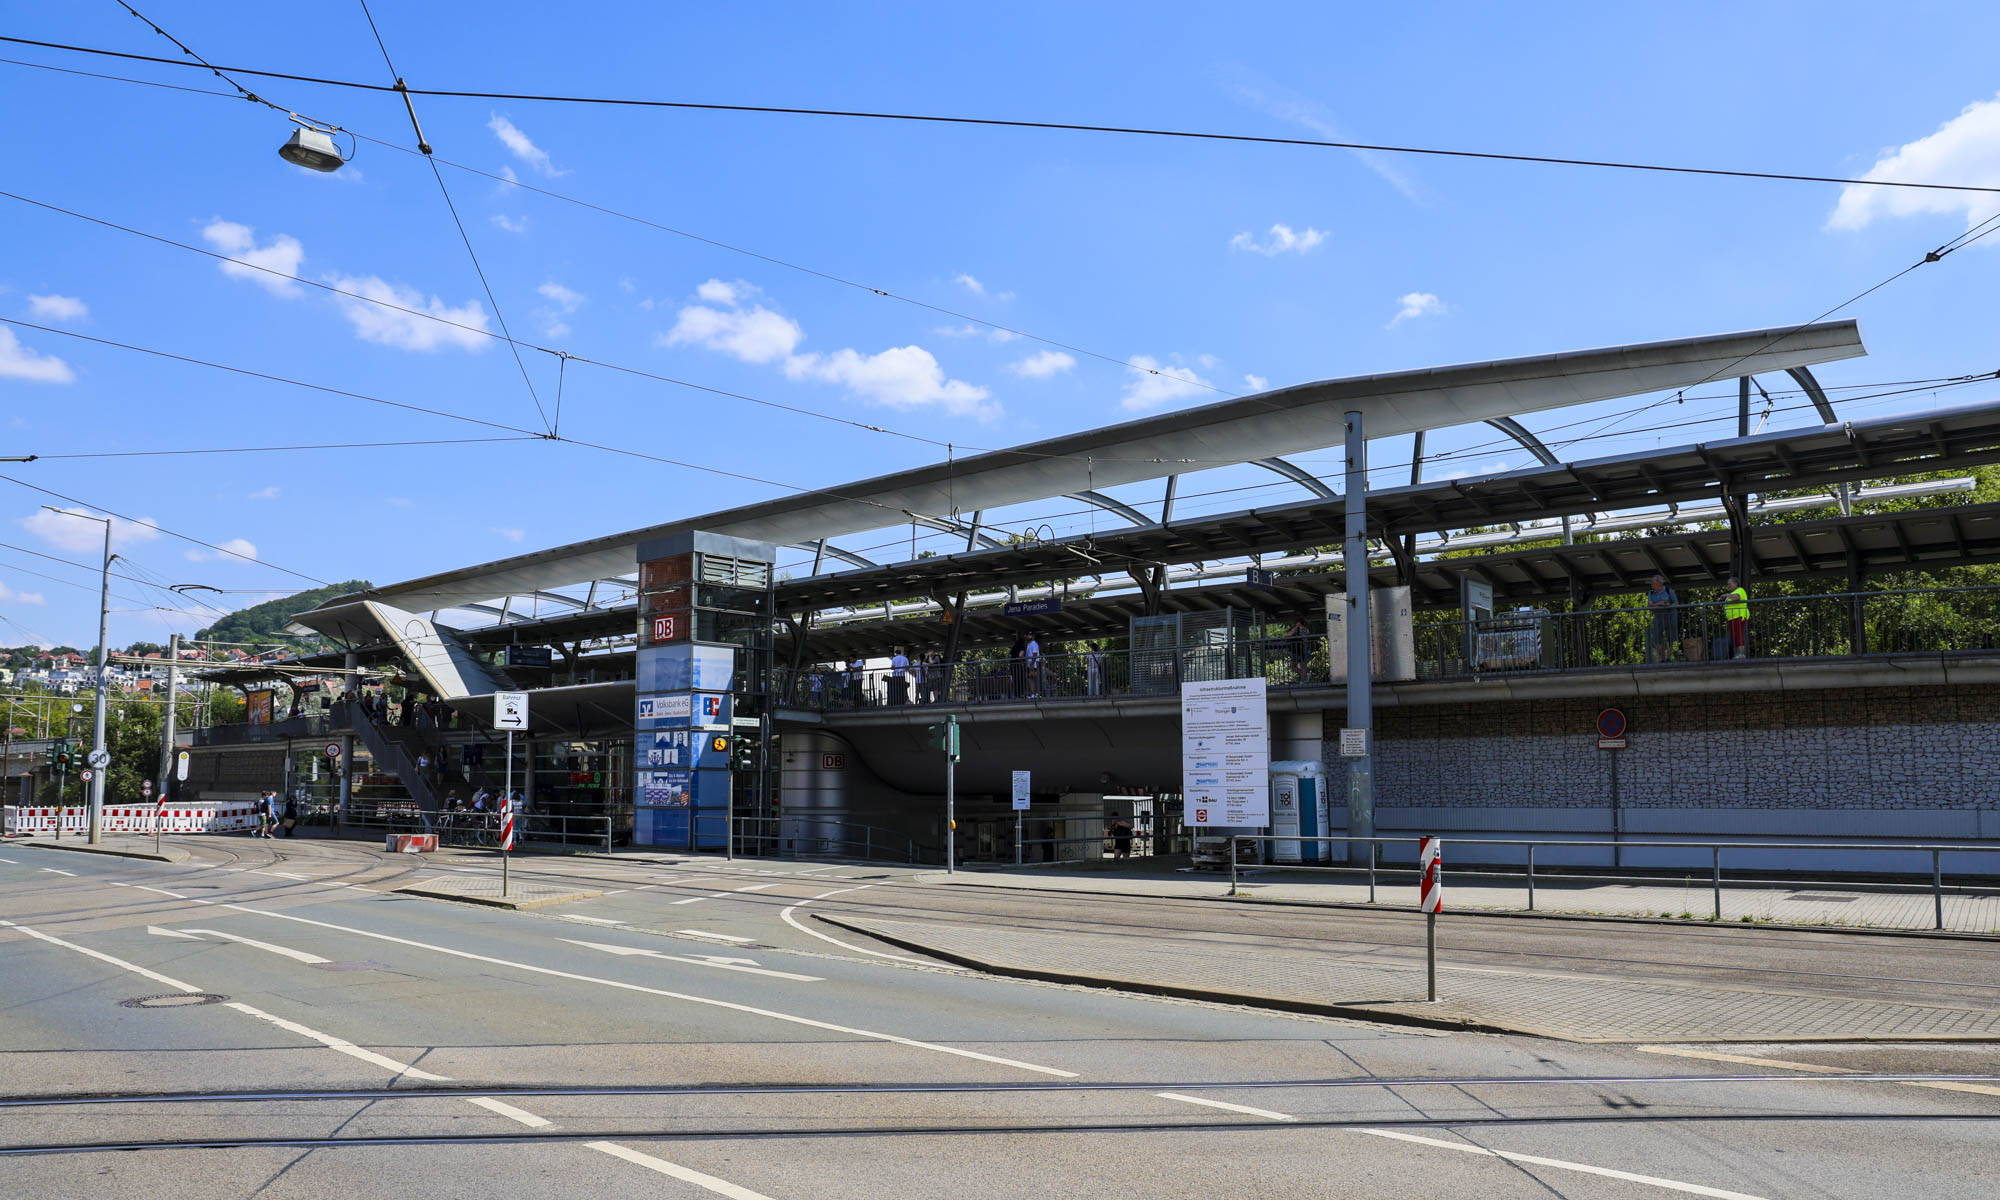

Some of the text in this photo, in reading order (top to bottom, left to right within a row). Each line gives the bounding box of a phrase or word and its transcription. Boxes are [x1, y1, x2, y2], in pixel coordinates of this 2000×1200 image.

[1252, 570, 1259, 583] B
[1007, 603, 1048, 613] Jena Paradies
[656, 620, 672, 637] DB
[656, 698, 681, 709] Volksbank
[91, 754, 106, 764] 30
[826, 756, 842, 766] DB
